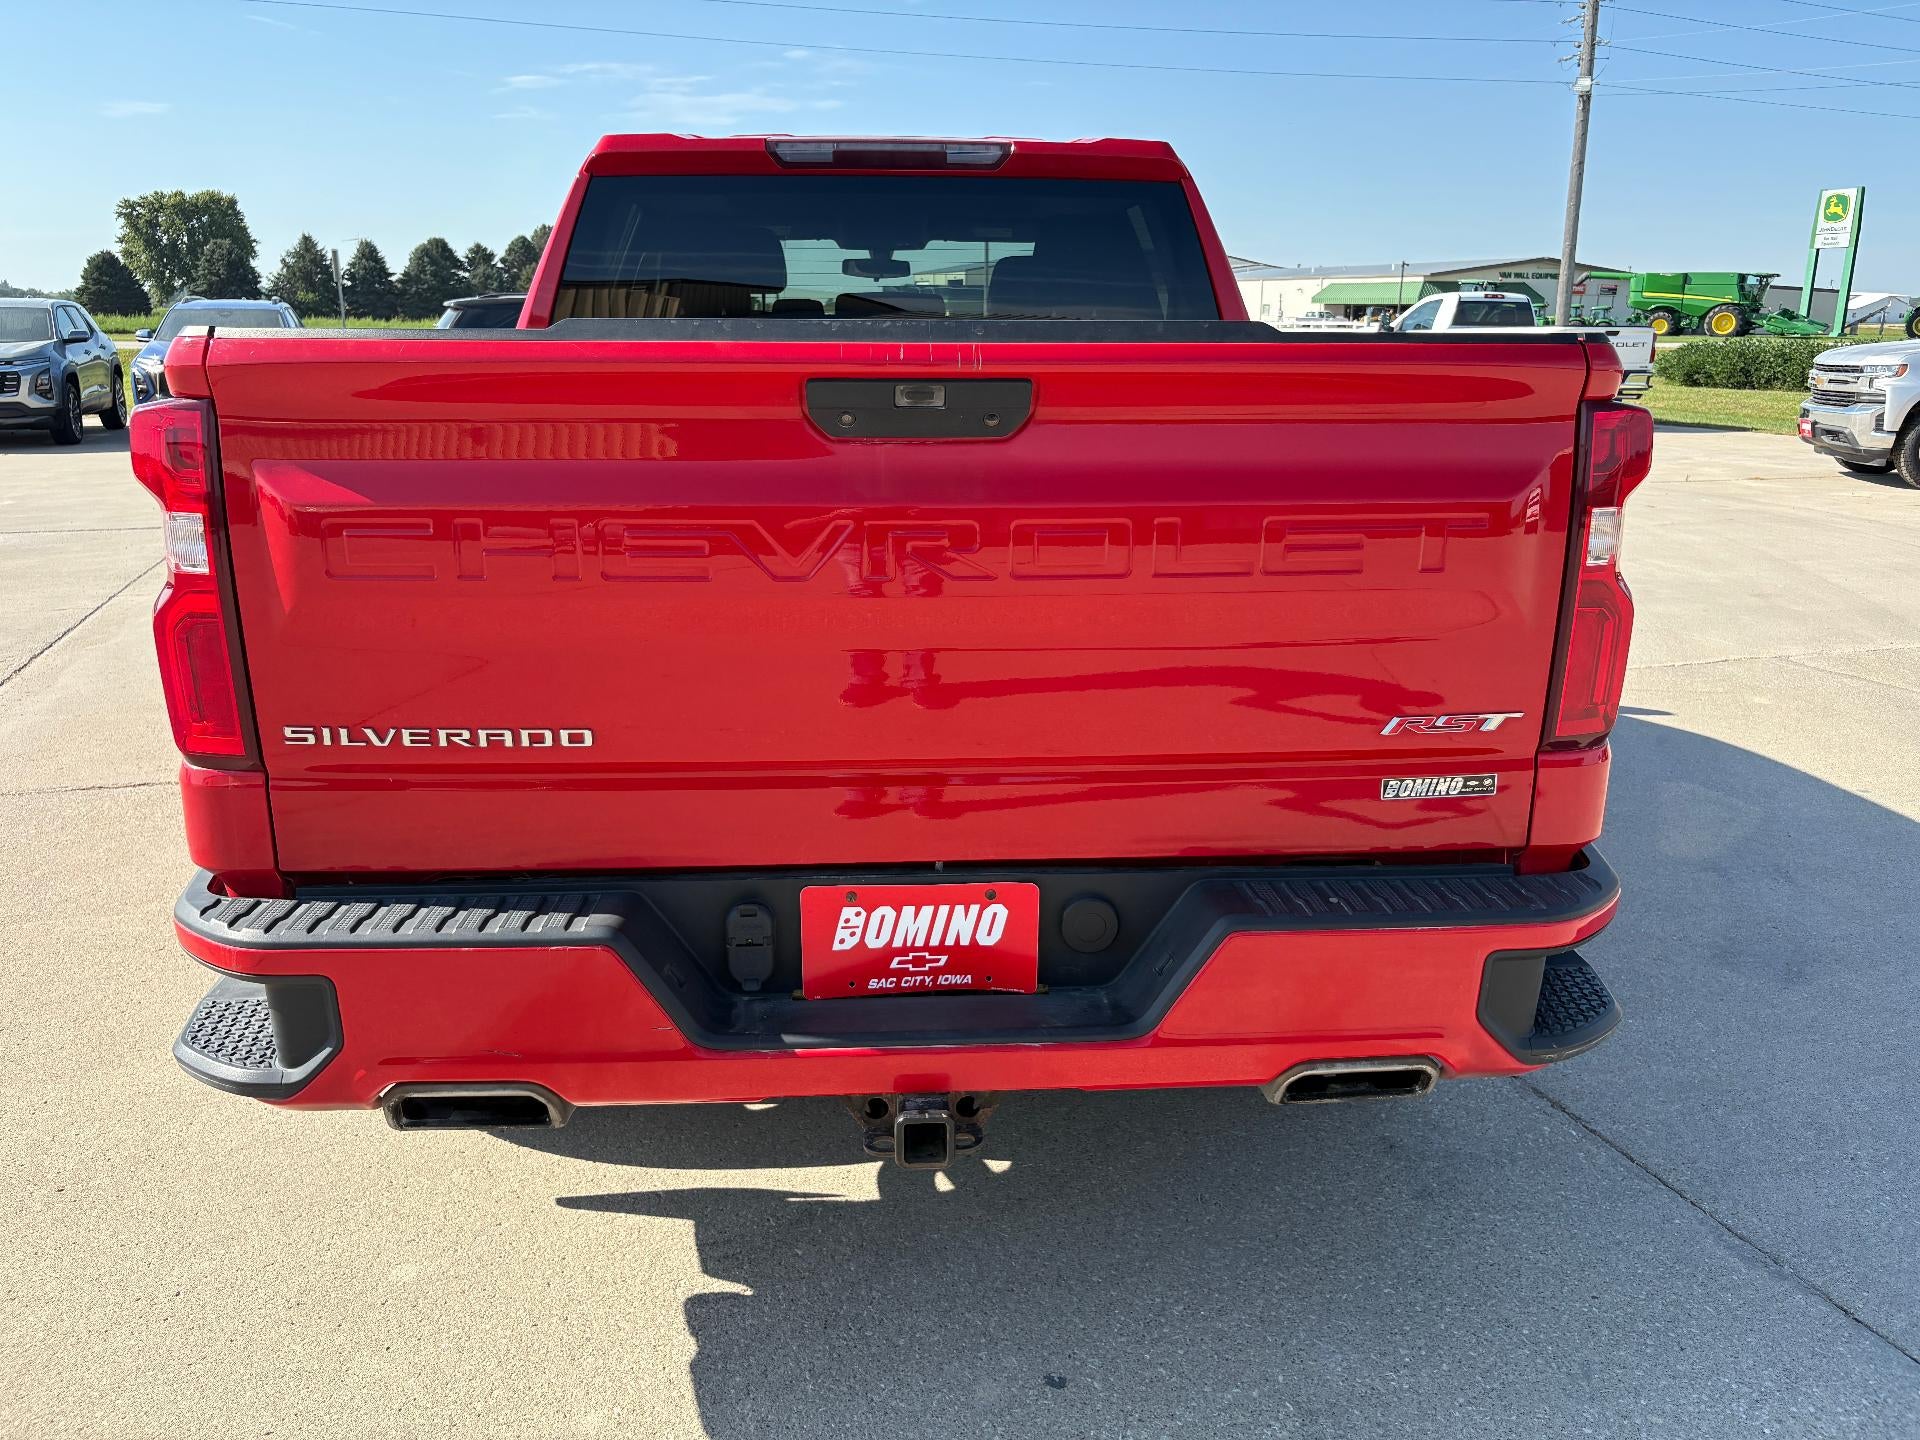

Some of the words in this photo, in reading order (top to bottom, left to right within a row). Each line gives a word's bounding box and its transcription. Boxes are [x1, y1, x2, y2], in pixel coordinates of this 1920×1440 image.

[1531, 272, 1561, 280] EQUIPME
[321, 513, 1489, 582] CHEVROLET
[1380, 712, 1525, 736] RST
[283, 726, 594, 748] SILVERADO
[1383, 777, 1464, 798] DOMINO
[832, 903, 1008, 951] DOMINO
[868, 978, 897, 989] SAC
[901, 975, 933, 988] CITY,
[937, 974, 973, 985] IOWA
